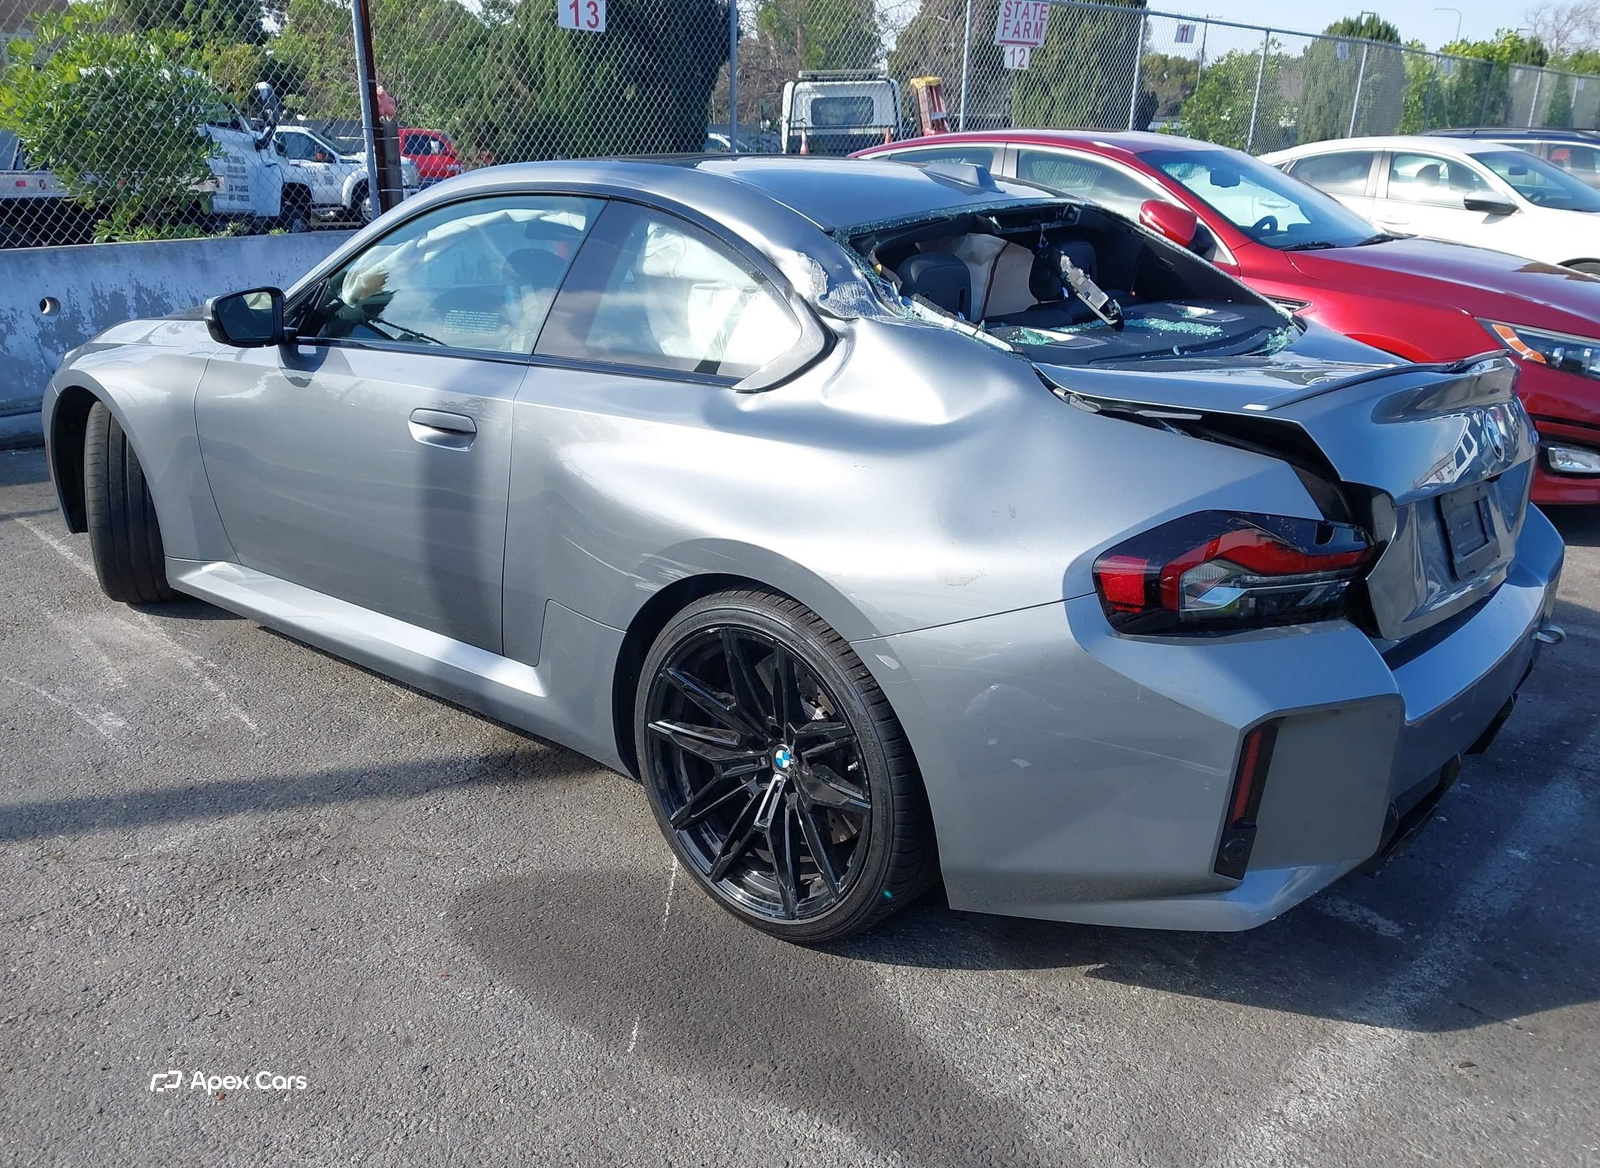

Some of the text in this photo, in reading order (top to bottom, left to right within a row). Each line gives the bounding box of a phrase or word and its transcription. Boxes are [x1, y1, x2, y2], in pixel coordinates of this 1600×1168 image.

[569, 0, 600, 29] 13
[1003, 1, 1048, 21] STATE
[1001, 19, 1043, 39] FARM
[1180, 24, 1190, 42] 11
[1009, 47, 1026, 68] 12
